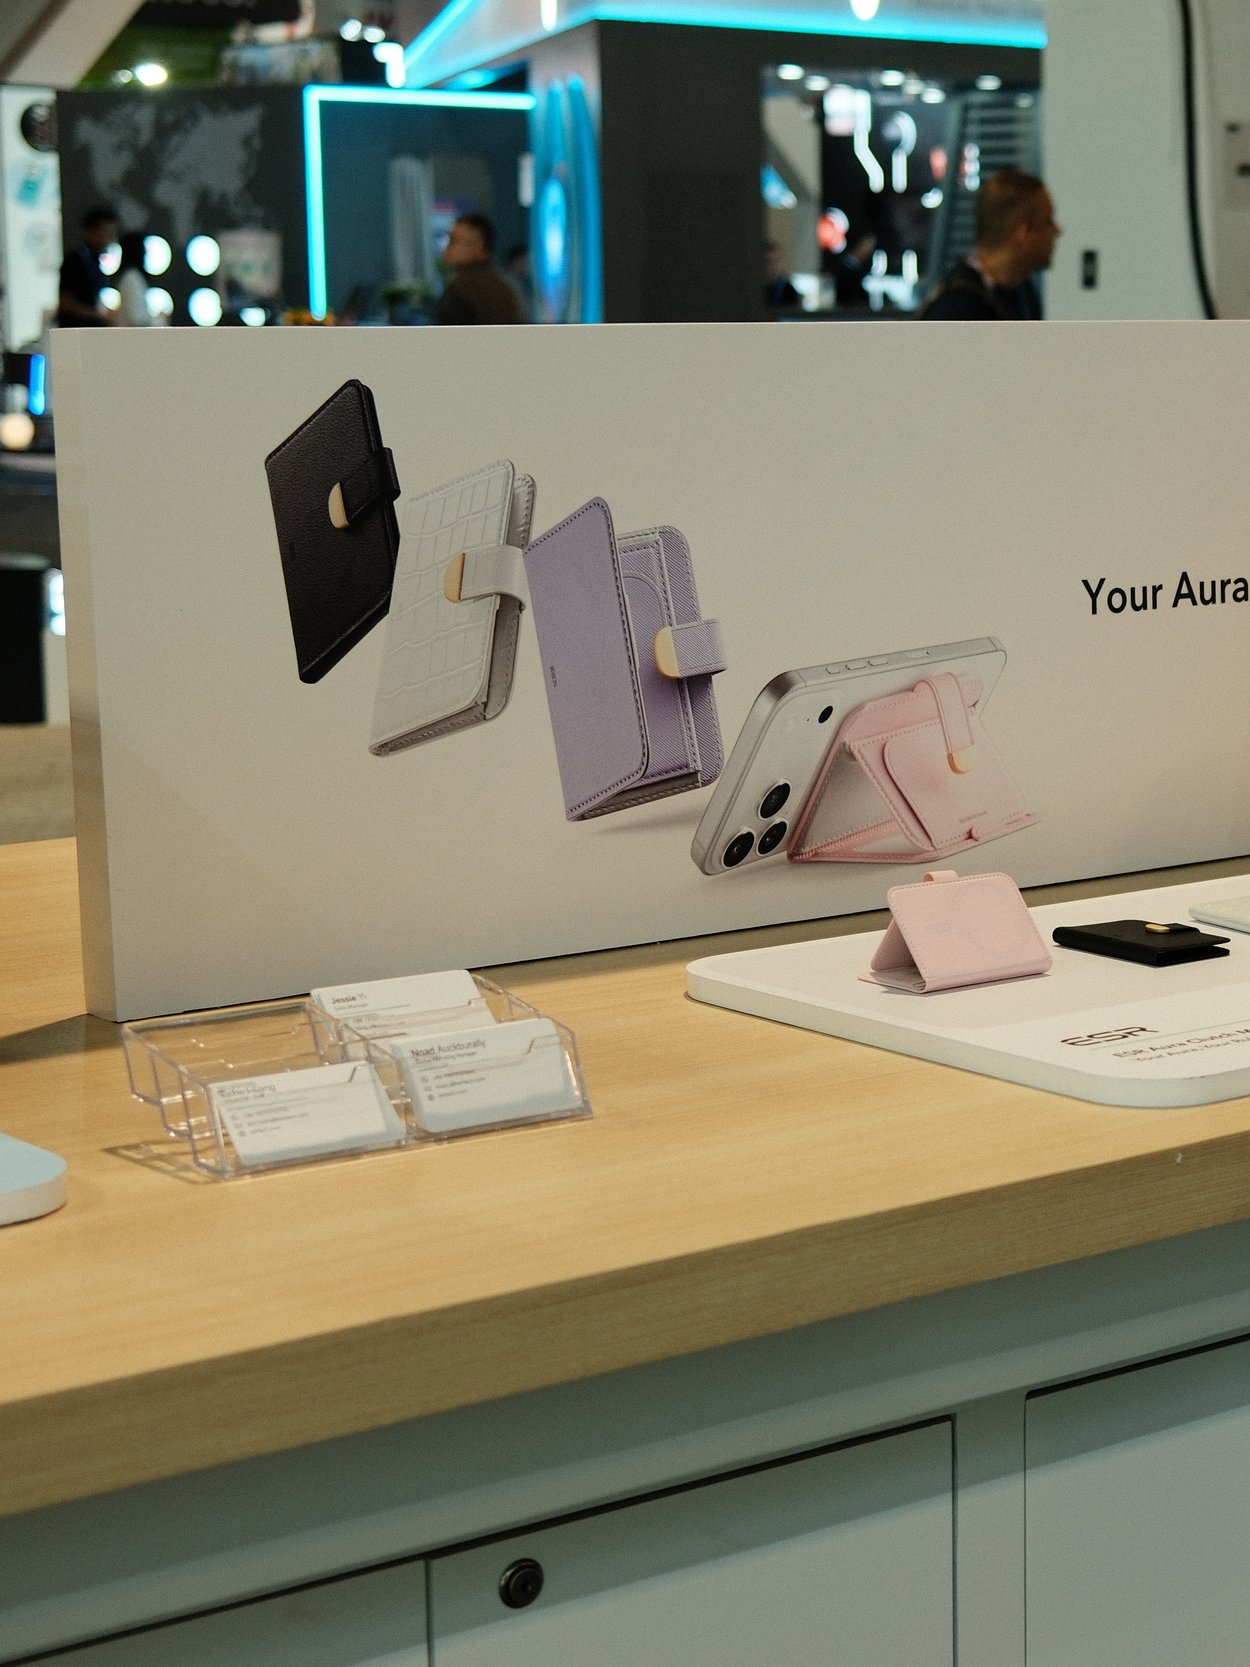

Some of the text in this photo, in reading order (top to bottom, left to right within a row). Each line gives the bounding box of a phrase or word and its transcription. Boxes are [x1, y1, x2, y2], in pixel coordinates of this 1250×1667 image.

[1082, 577, 1163, 615] Your
[332, 996, 357, 1004] Jessie
[1060, 1026, 1159, 1047] ESR
[1148, 1042, 1187, 1051] Aura
[1187, 1031, 1236, 1044] Clutch
